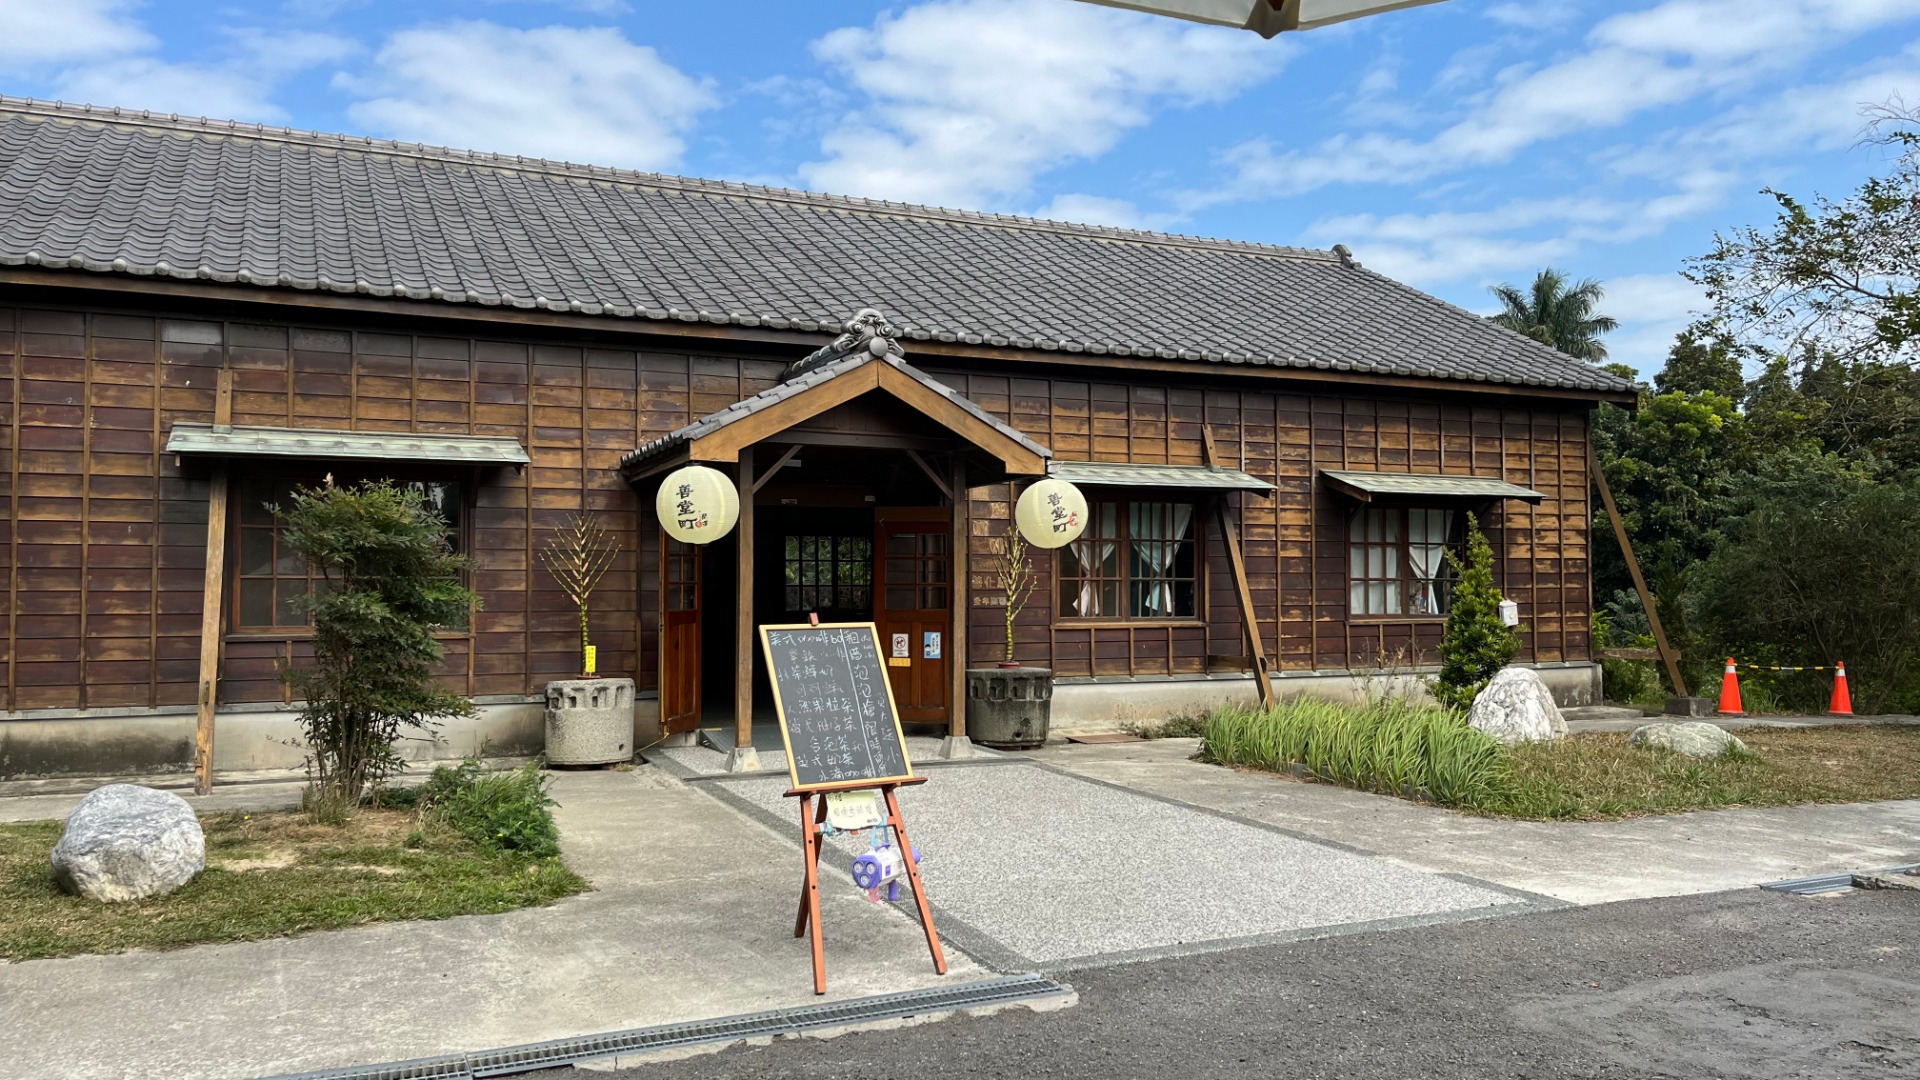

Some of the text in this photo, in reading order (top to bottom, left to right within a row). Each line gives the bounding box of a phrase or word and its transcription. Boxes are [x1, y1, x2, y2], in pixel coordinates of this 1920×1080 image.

[676, 484, 698, 530] 善堂町
[1047, 492, 1071, 533] 善堂町
